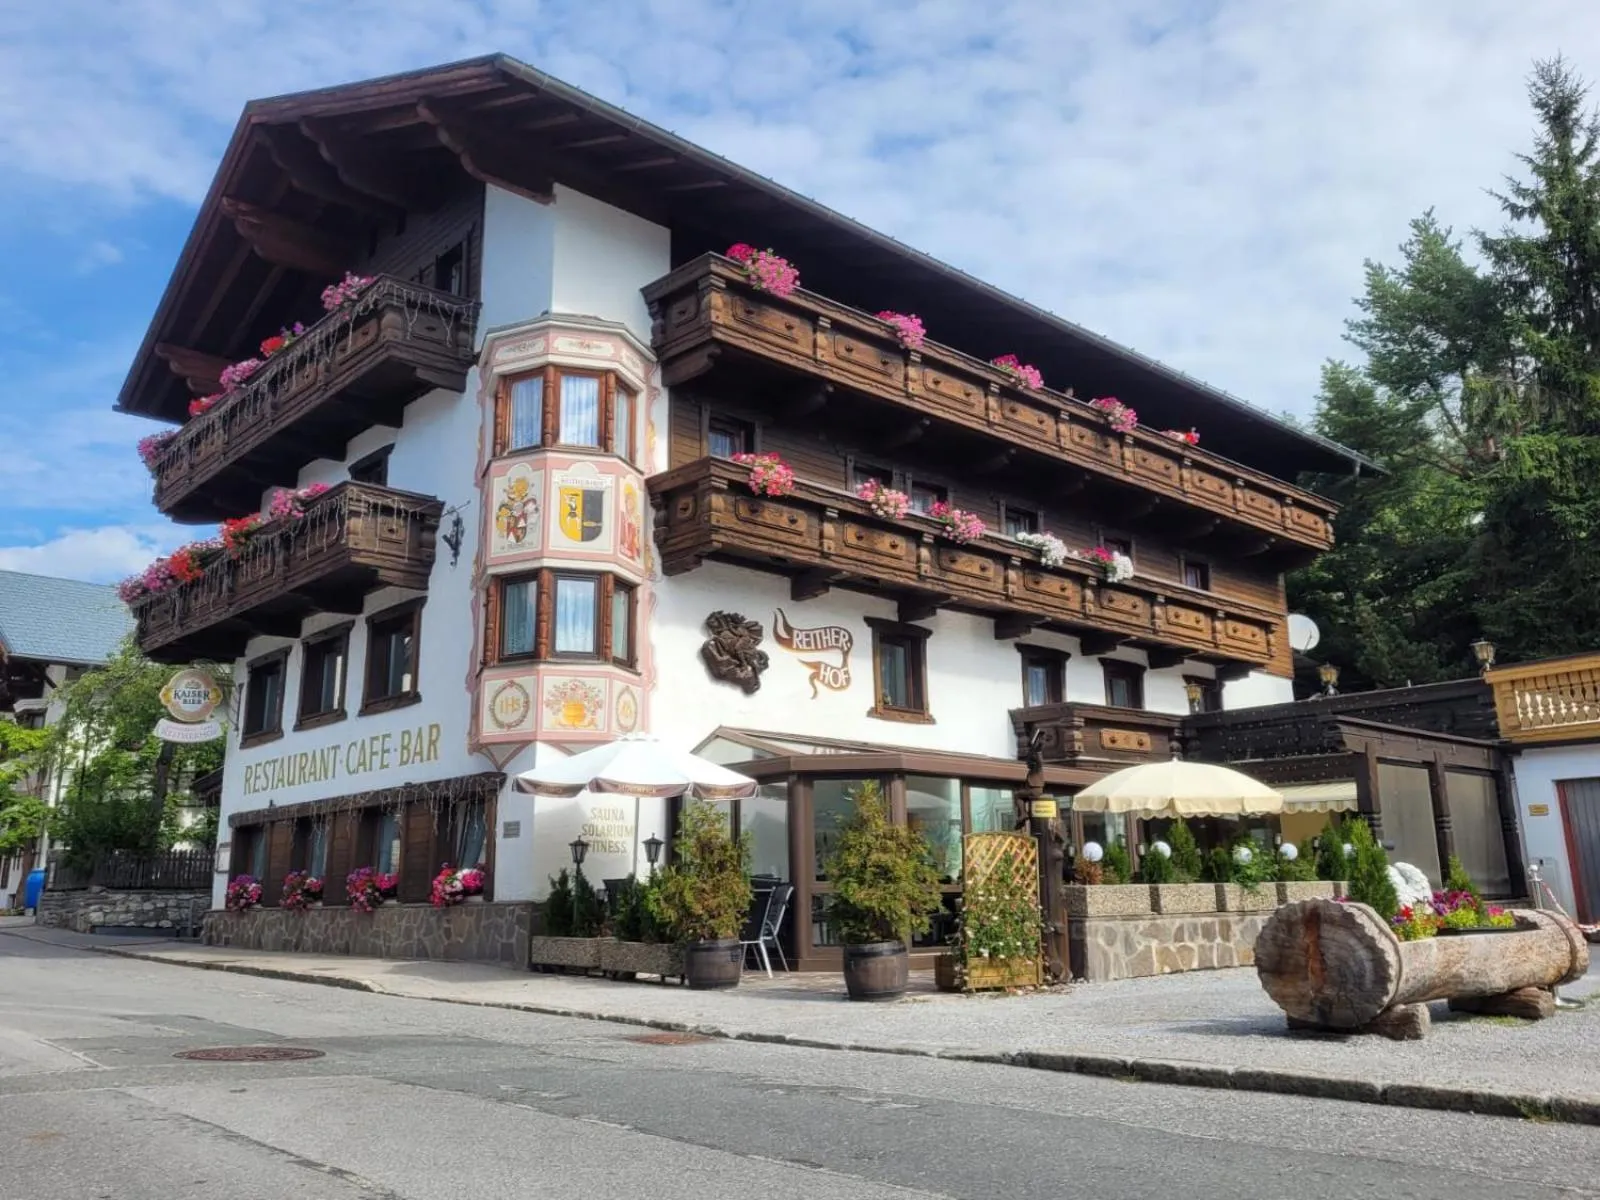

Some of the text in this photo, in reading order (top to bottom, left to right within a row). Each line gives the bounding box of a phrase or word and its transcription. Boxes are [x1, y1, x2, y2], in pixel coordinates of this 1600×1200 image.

[793, 627, 849, 651] REITHER
[820, 663, 850, 688] HOF
[174, 689, 209, 700] KAISER
[243, 723, 441, 796] RESTAURANT CAFE BAR
[590, 807, 625, 821] SAUNA
[581, 823, 636, 838] SOLARIUM
